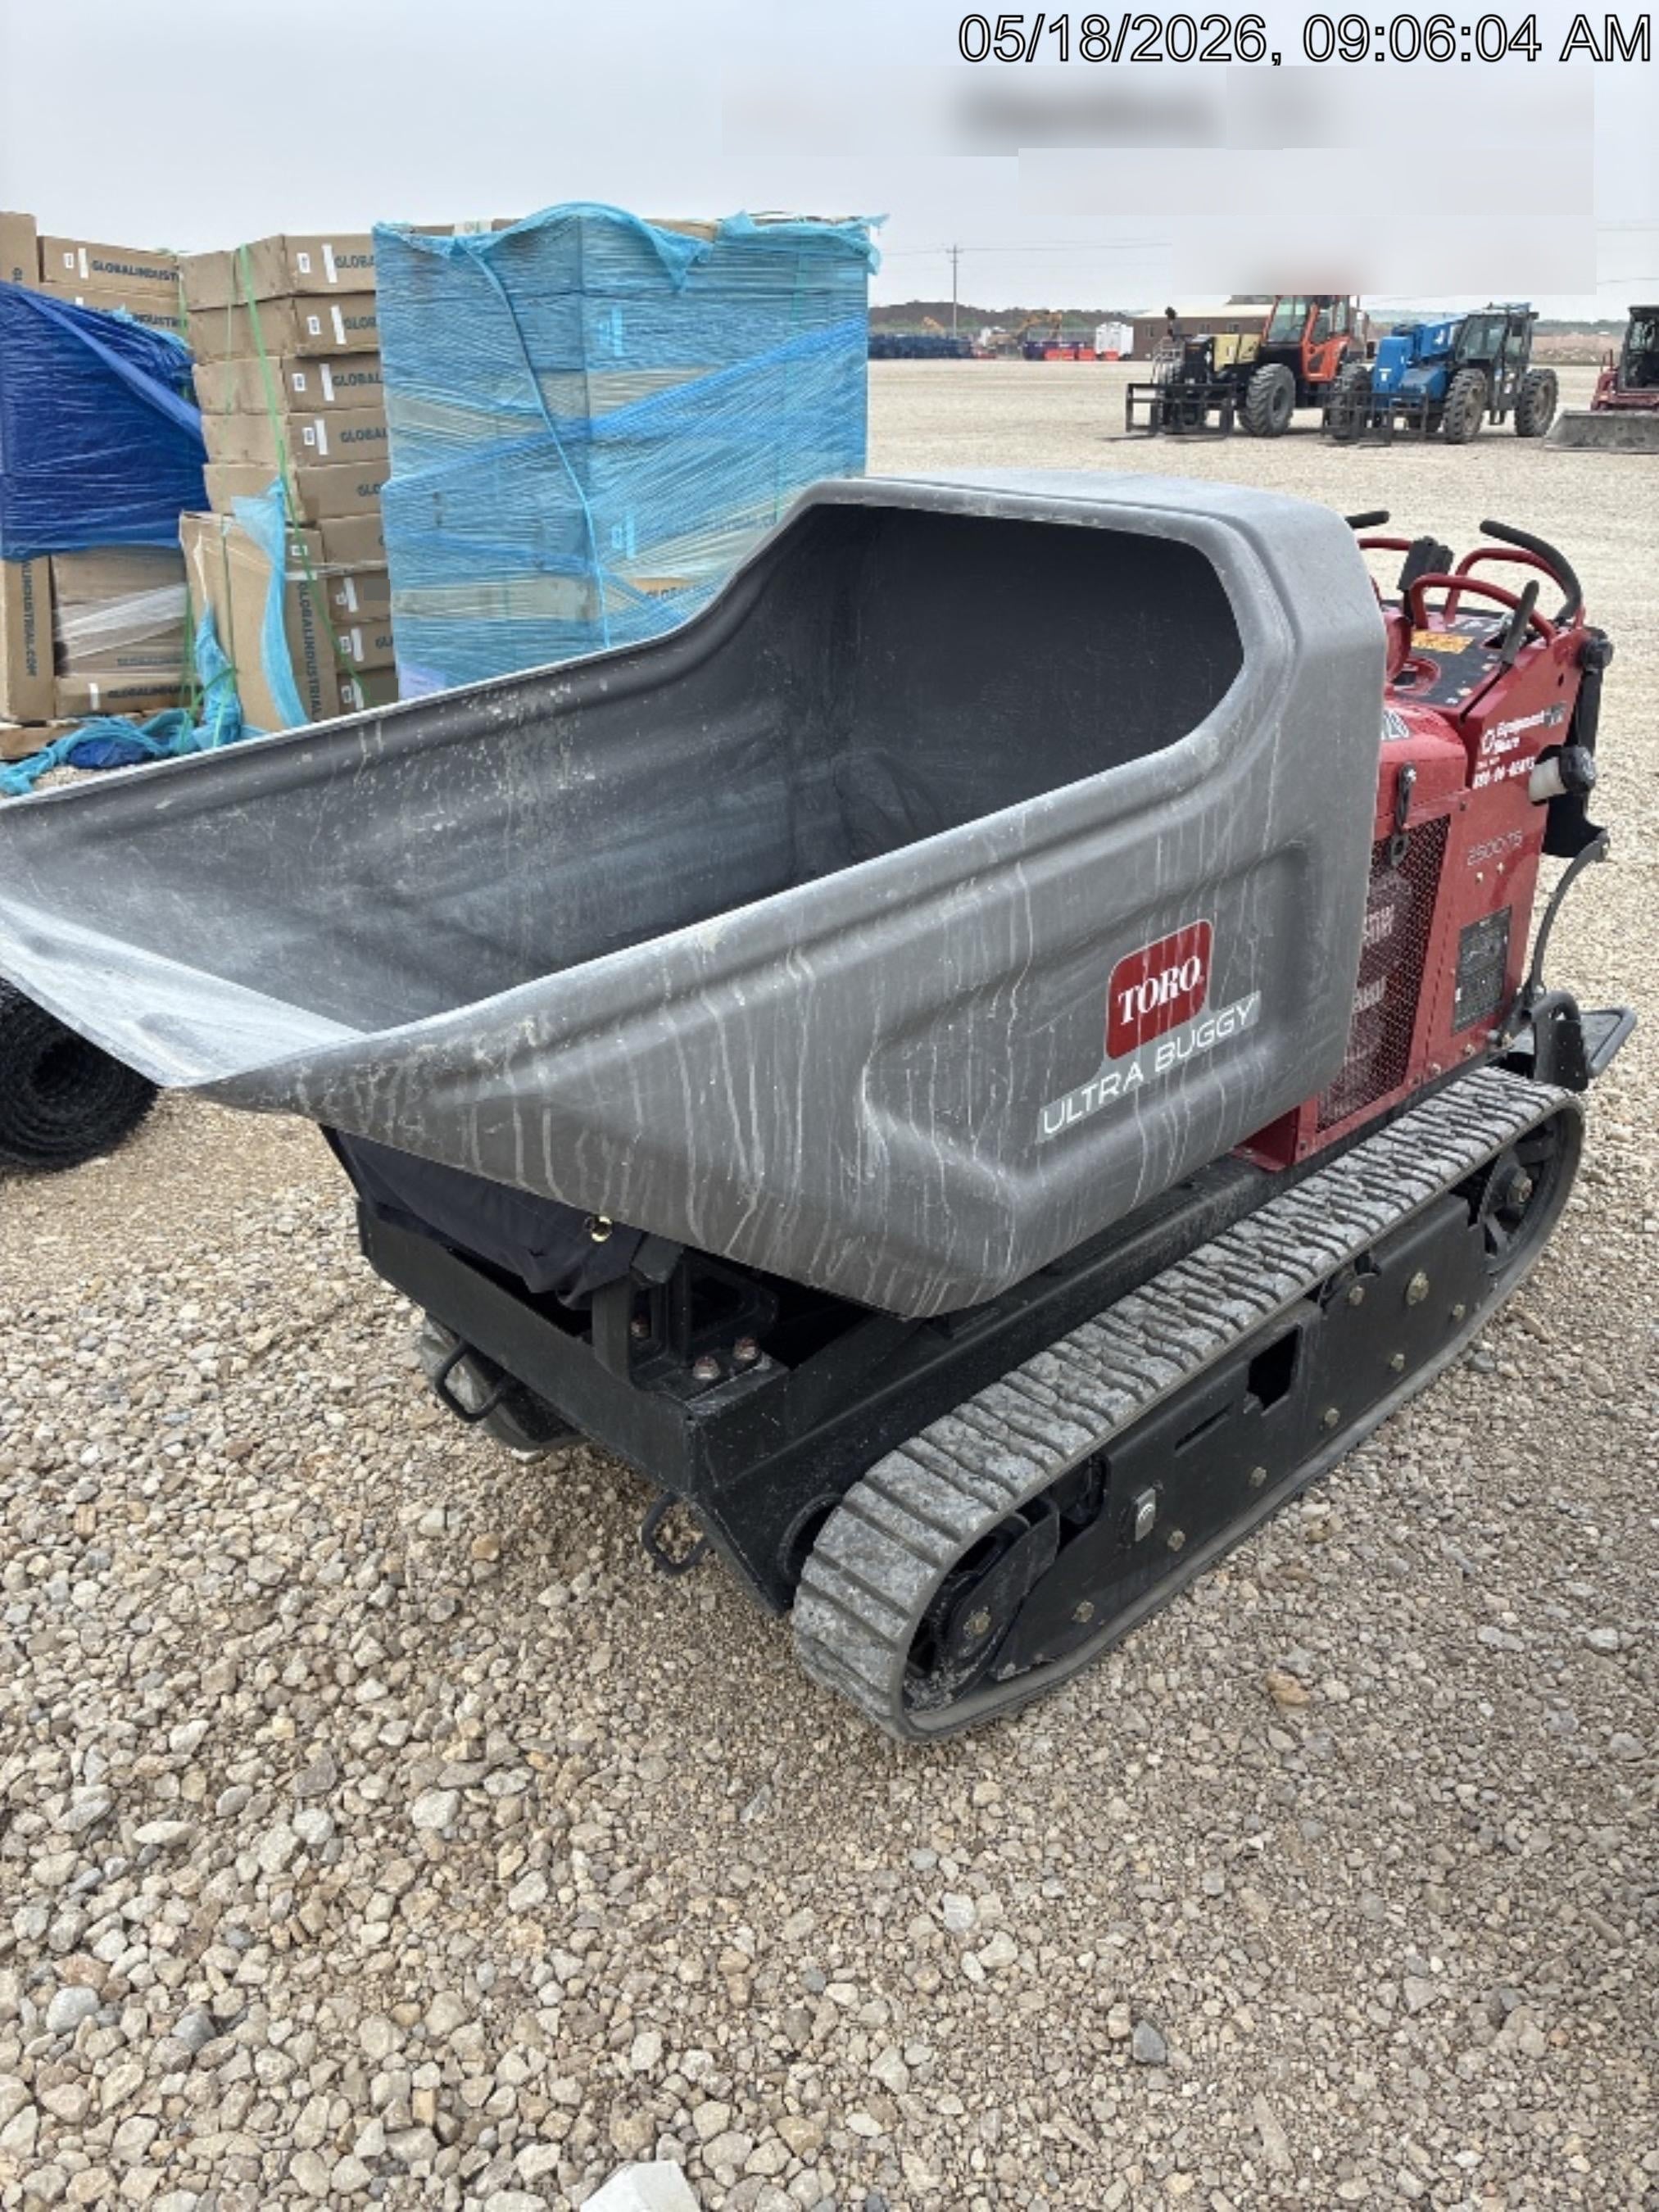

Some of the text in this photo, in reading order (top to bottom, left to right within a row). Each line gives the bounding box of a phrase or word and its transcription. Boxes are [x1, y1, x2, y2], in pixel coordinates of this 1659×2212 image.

[1117, 955, 1202, 1025] TORO
[1043, 1061, 1145, 1135] ULTRA
[1155, 992, 1259, 1073] BUGGY
